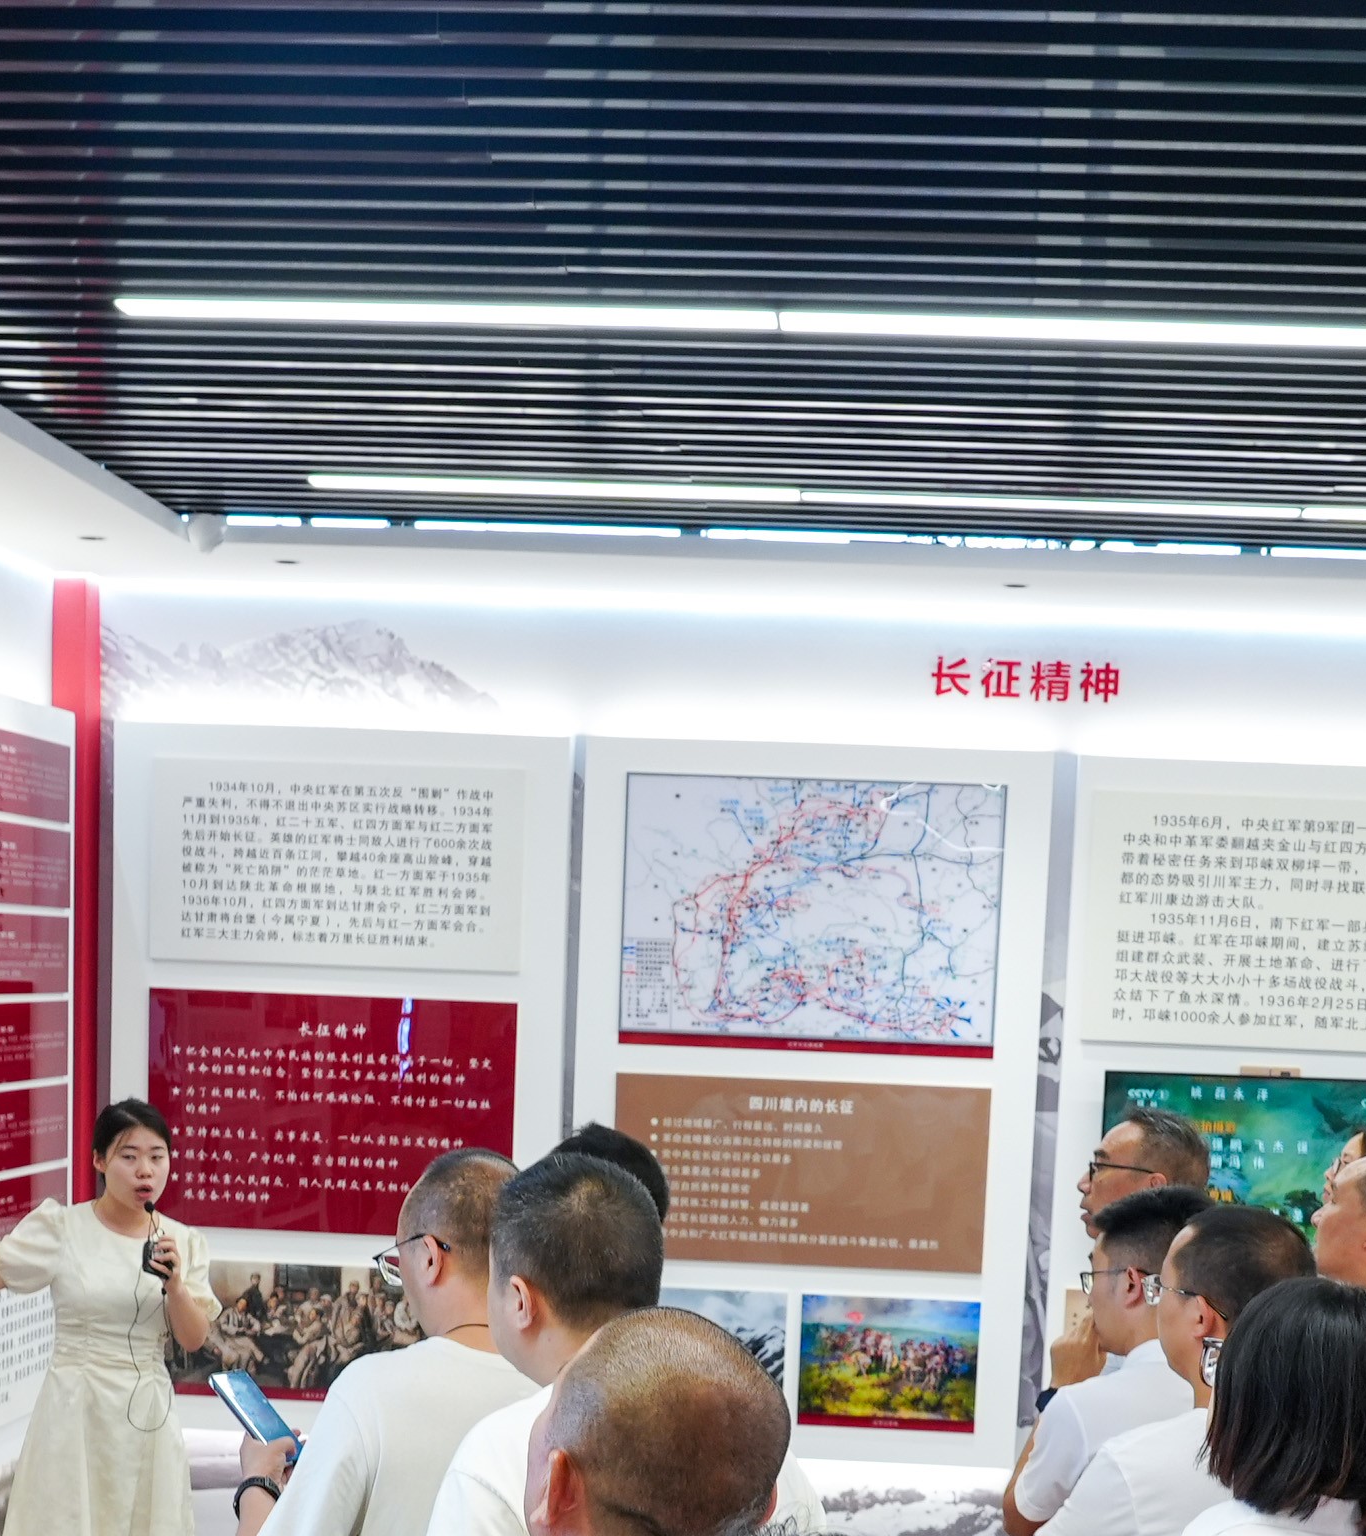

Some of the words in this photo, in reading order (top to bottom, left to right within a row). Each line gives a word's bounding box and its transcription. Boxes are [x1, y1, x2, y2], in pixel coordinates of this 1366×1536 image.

[931, 656, 1120, 703] 长征精神
[1119, 891, 1265, 910] 红军川康边游击大队。
[298, 1021, 367, 1040] 长征精神
[1128, 1088, 1155, 1099] CCTV
[185, 1102, 221, 1116] 的精神
[749, 1095, 854, 1115] 四川境内的长征
